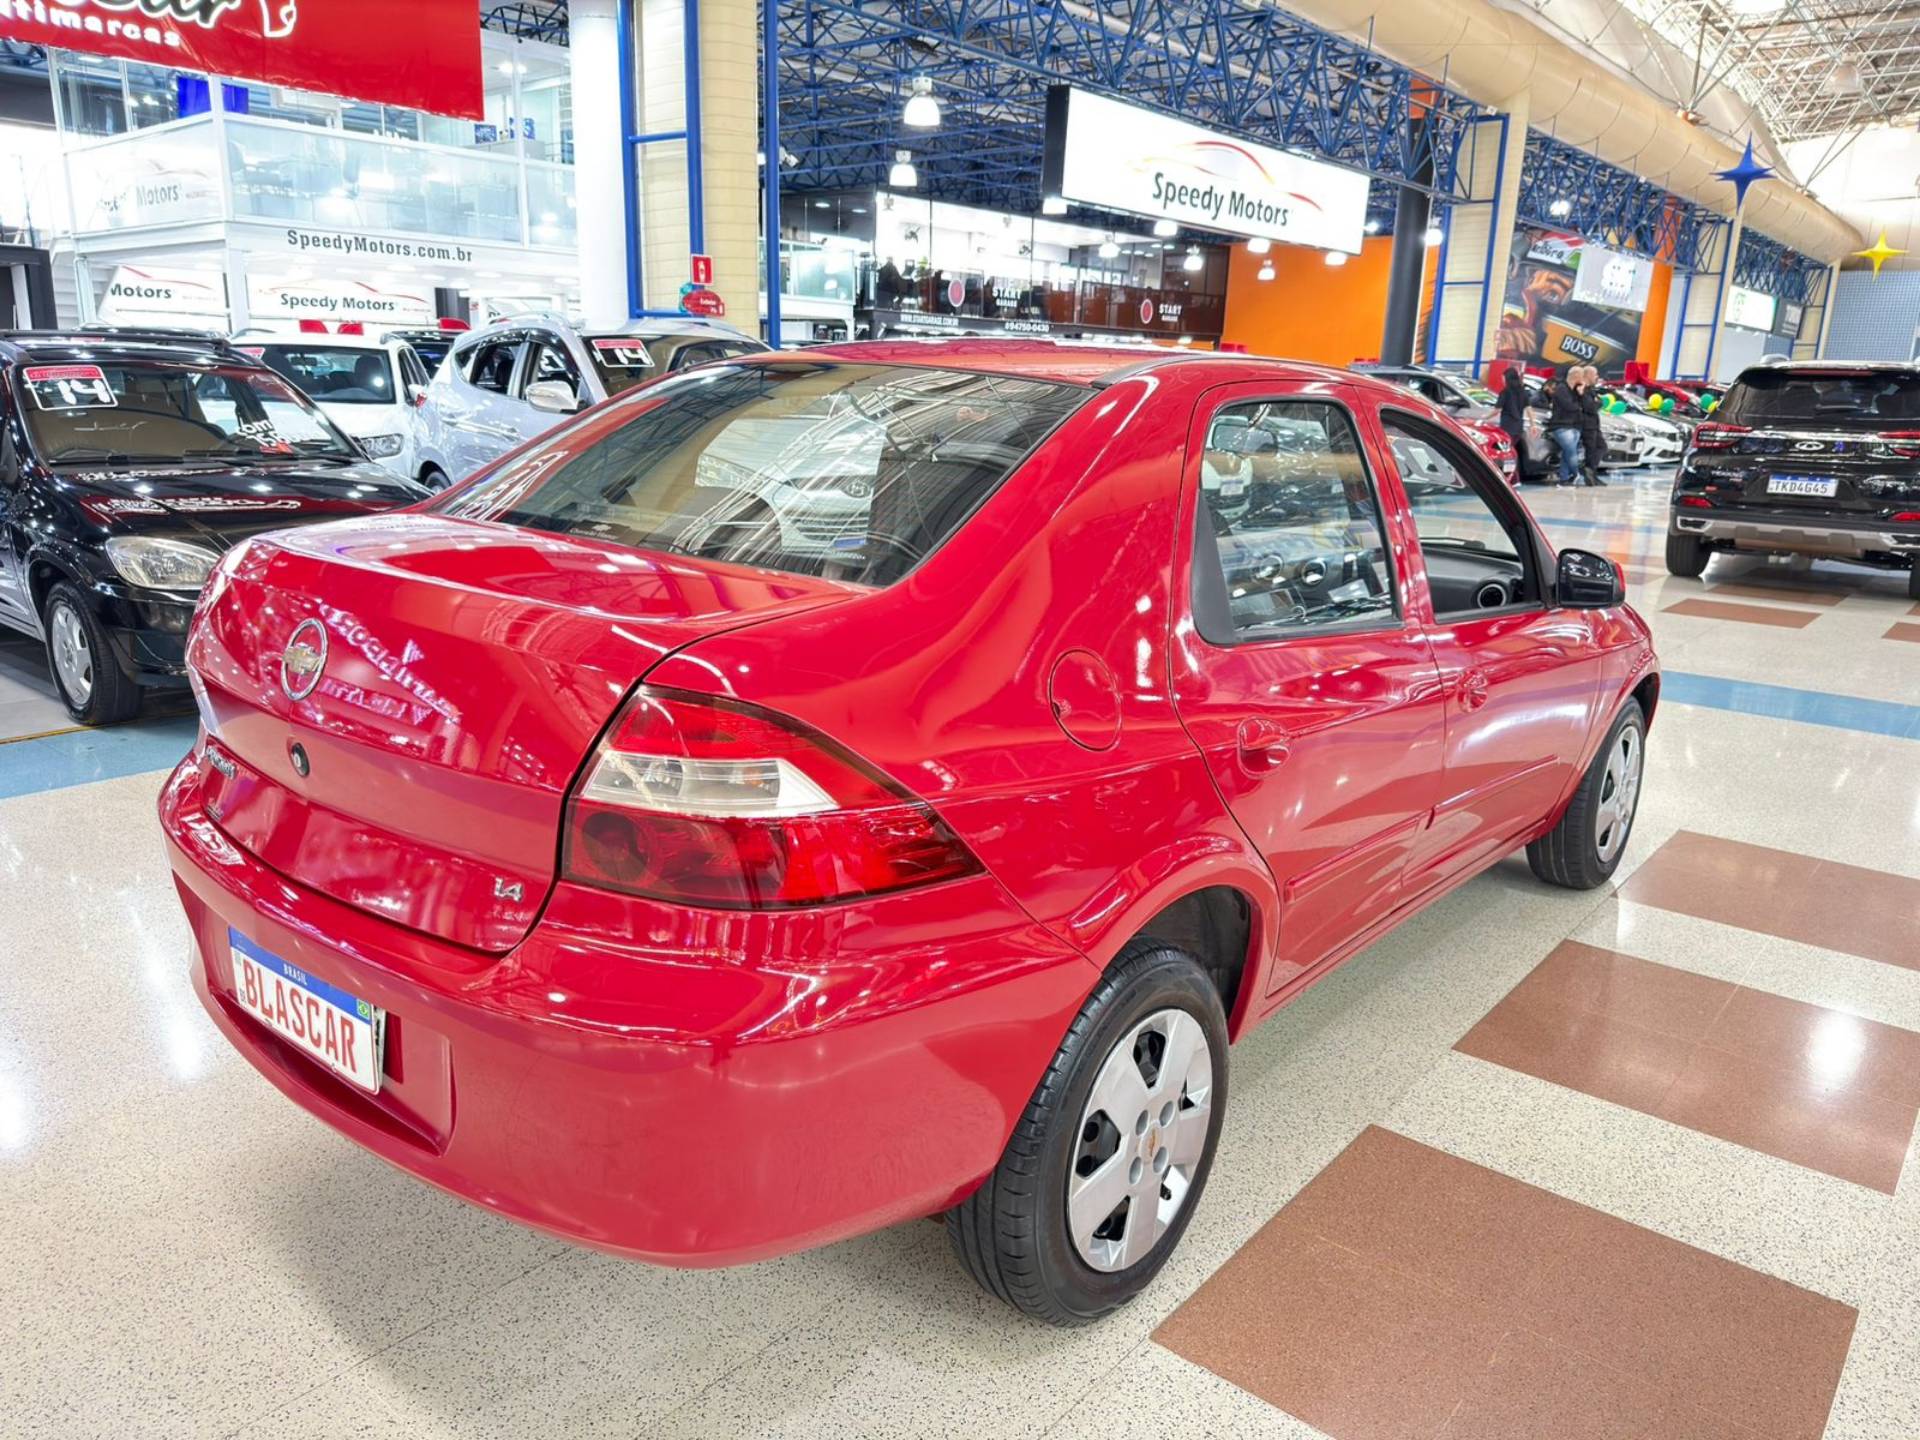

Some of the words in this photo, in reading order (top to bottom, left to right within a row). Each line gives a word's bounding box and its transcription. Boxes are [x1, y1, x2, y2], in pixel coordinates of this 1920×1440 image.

[1152, 171, 1224, 221] Speedy
[1228, 190, 1289, 227] Motors
[287, 229, 473, 262] SpeedyMotors.com.br
[280, 293, 338, 312] Speedy
[342, 297, 395, 312] Motors
[1159, 303, 1182, 315] START
[1561, 336, 1597, 359] BOSS
[57, 379, 111, 405] 14
[283, 963, 307, 985] BRASIL
[242, 958, 357, 1073] BLASCAR
